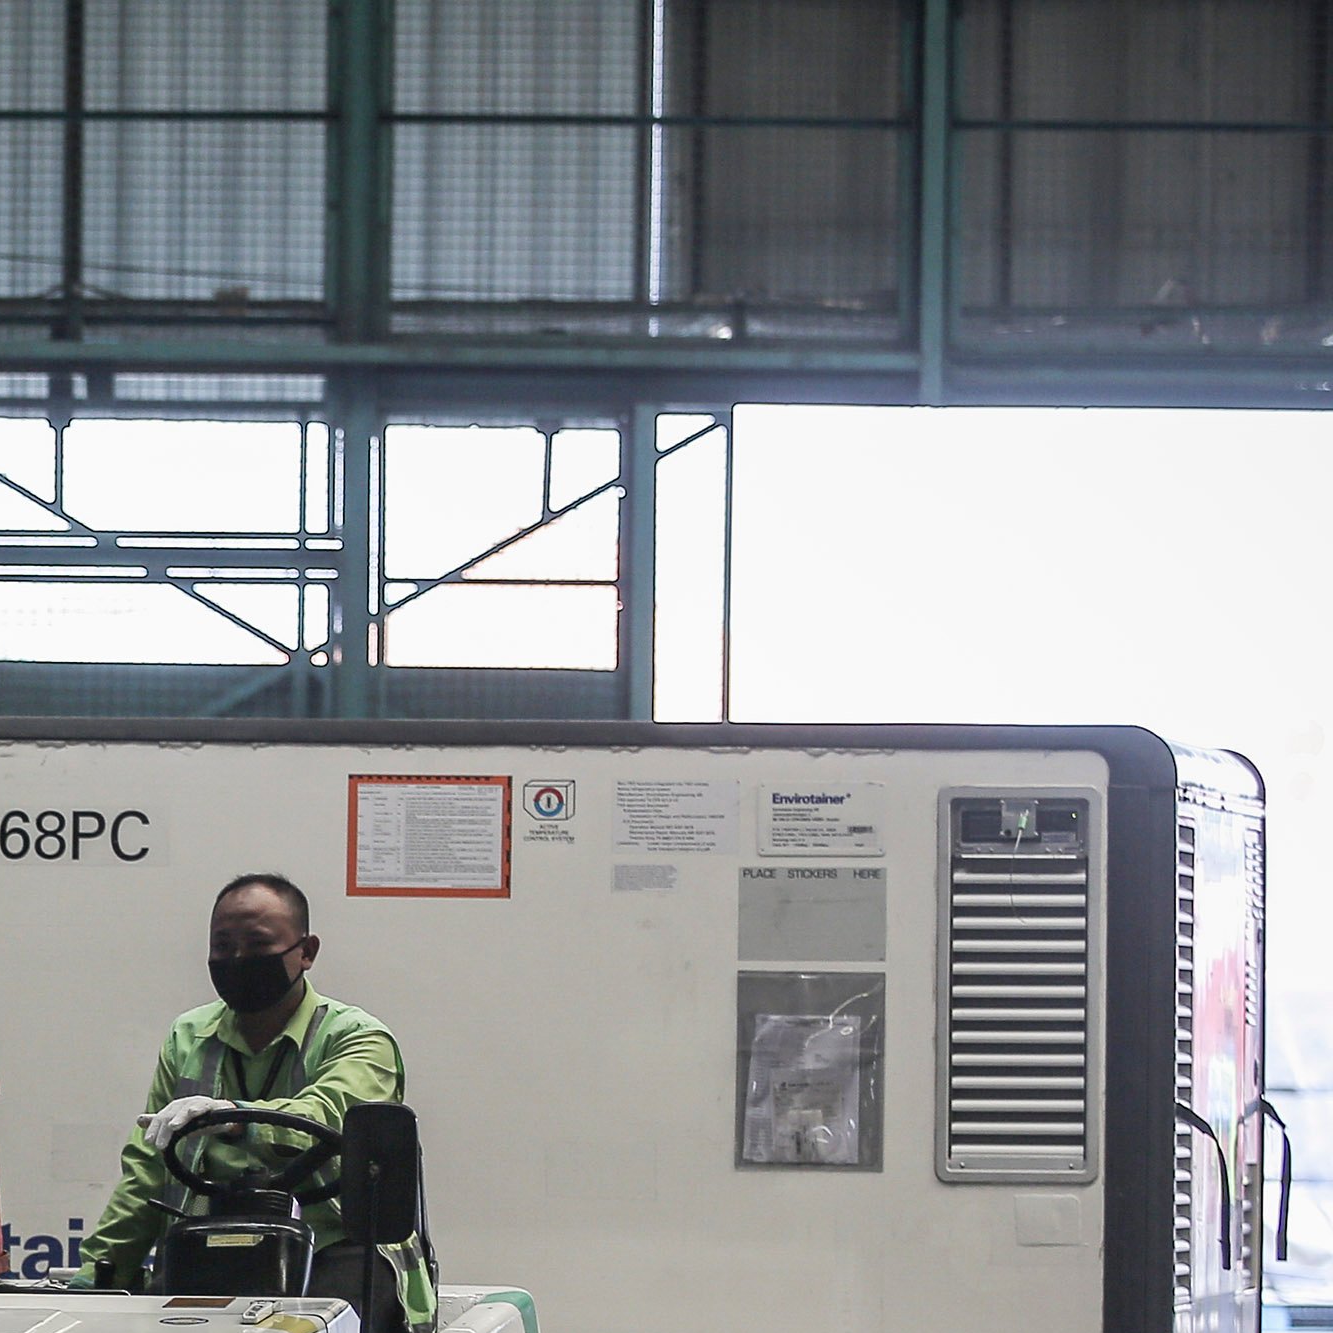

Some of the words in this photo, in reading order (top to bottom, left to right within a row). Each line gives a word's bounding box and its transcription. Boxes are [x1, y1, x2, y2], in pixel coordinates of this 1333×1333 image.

[743, 868, 776, 879] PLACE
[787, 868, 838, 879] STICKERS
[853, 869, 881, 879] HERE
